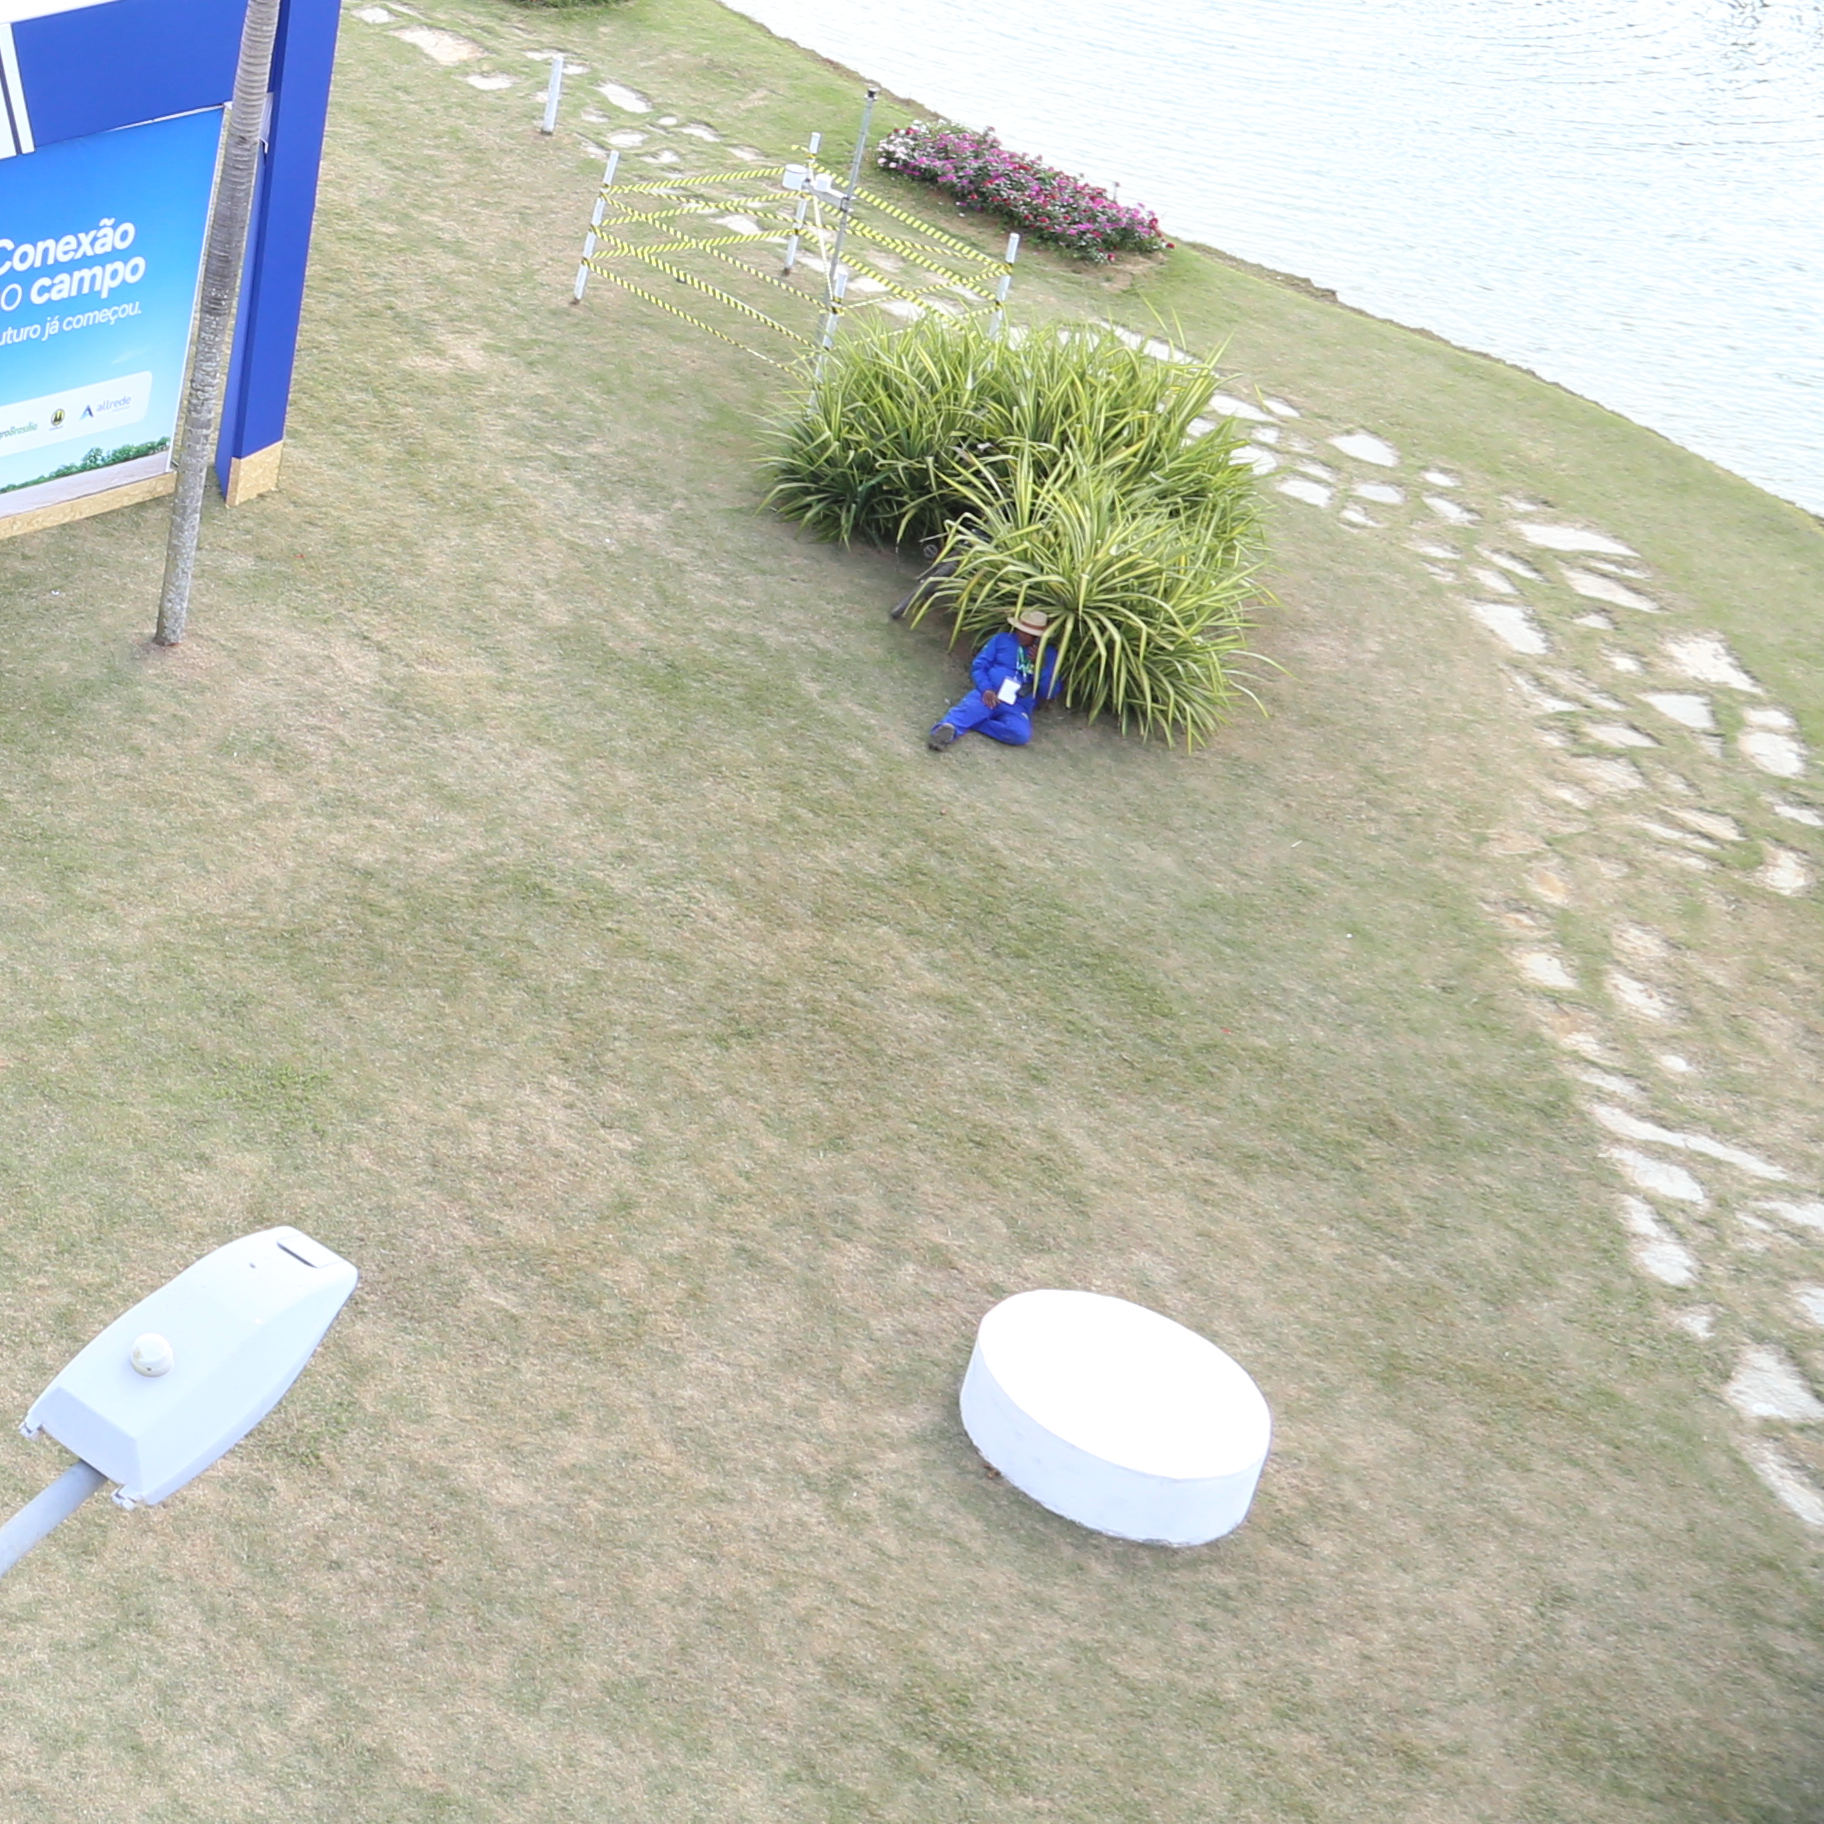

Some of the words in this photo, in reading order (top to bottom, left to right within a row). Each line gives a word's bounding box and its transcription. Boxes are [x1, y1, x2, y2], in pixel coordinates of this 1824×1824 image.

[30, 256, 146, 305] campo
[42, 314, 59, 342] já
[62, 300, 142, 332] começou.
[96, 395, 132, 413] allrede
